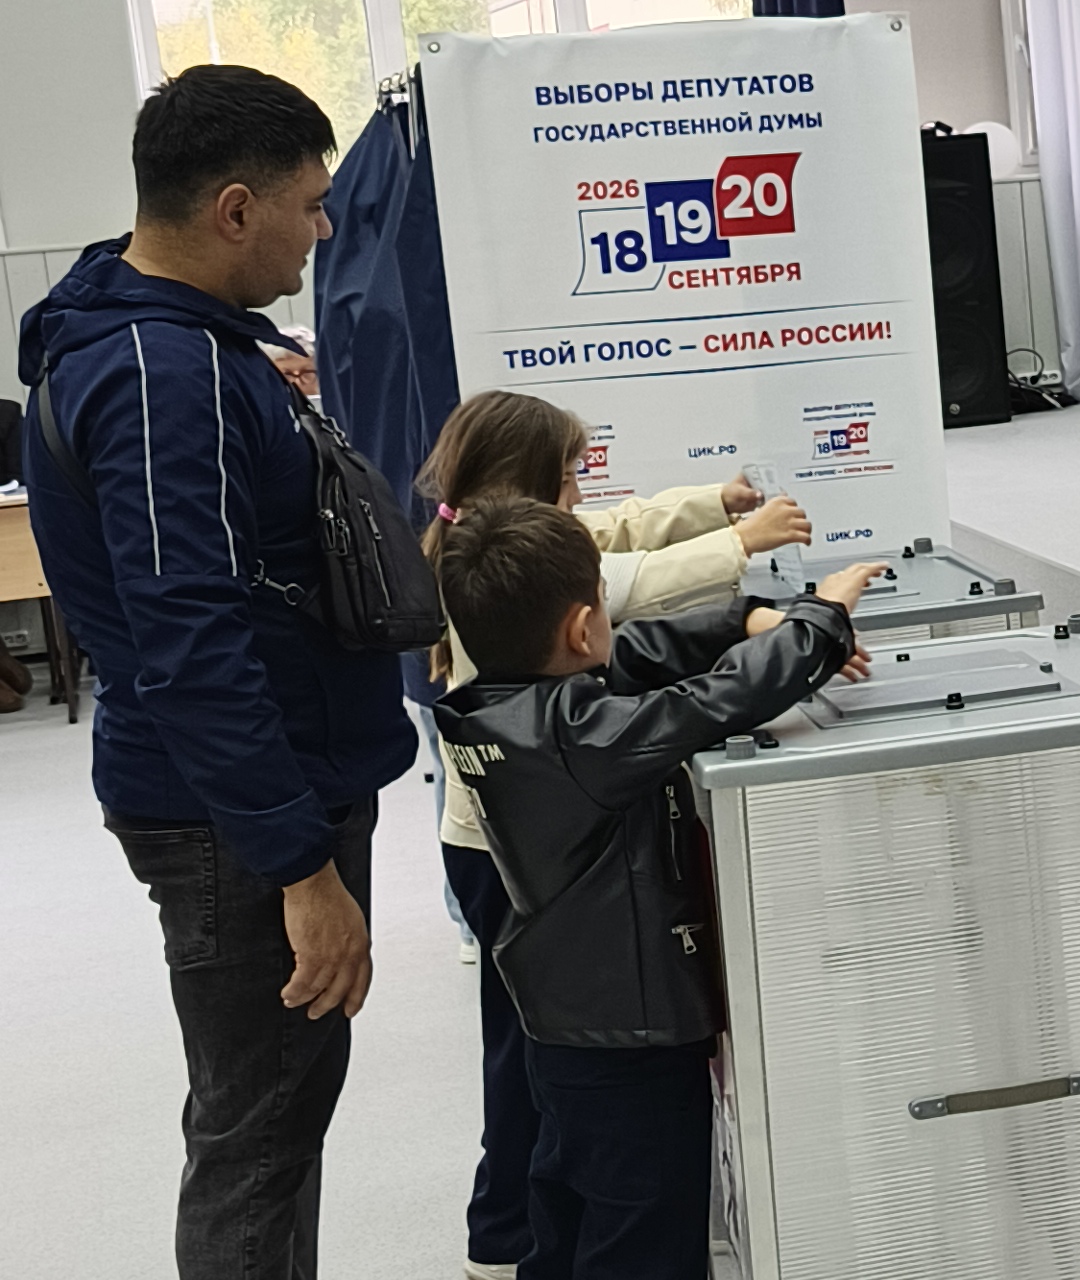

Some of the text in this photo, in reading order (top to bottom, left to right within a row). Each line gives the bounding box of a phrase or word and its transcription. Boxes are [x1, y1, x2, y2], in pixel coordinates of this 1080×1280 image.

[535, 73, 814, 106] ВЫБОРЫ ДЕПУТАТОВ
[533, 111, 823, 143] ГОСУДАРСТВЕННОЙ ДУМЫ
[577, 179, 640, 201] 2026
[721, 172, 788, 219] 20
[655, 199, 712, 246] 19
[590, 229, 648, 274] 18
[667, 262, 801, 290] СЕНТЯБРЯ
[503, 340, 577, 369] ТВОЙ
[583, 337, 672, 363] ГОЛОС
[703, 331, 774, 354] СИЛА
[781, 320, 892, 348] РОССИИ!
[833, 434, 847, 447] 19
[849, 426, 866, 440] 20
[586, 450, 606, 464] 20
[816, 442, 831, 455] 18
